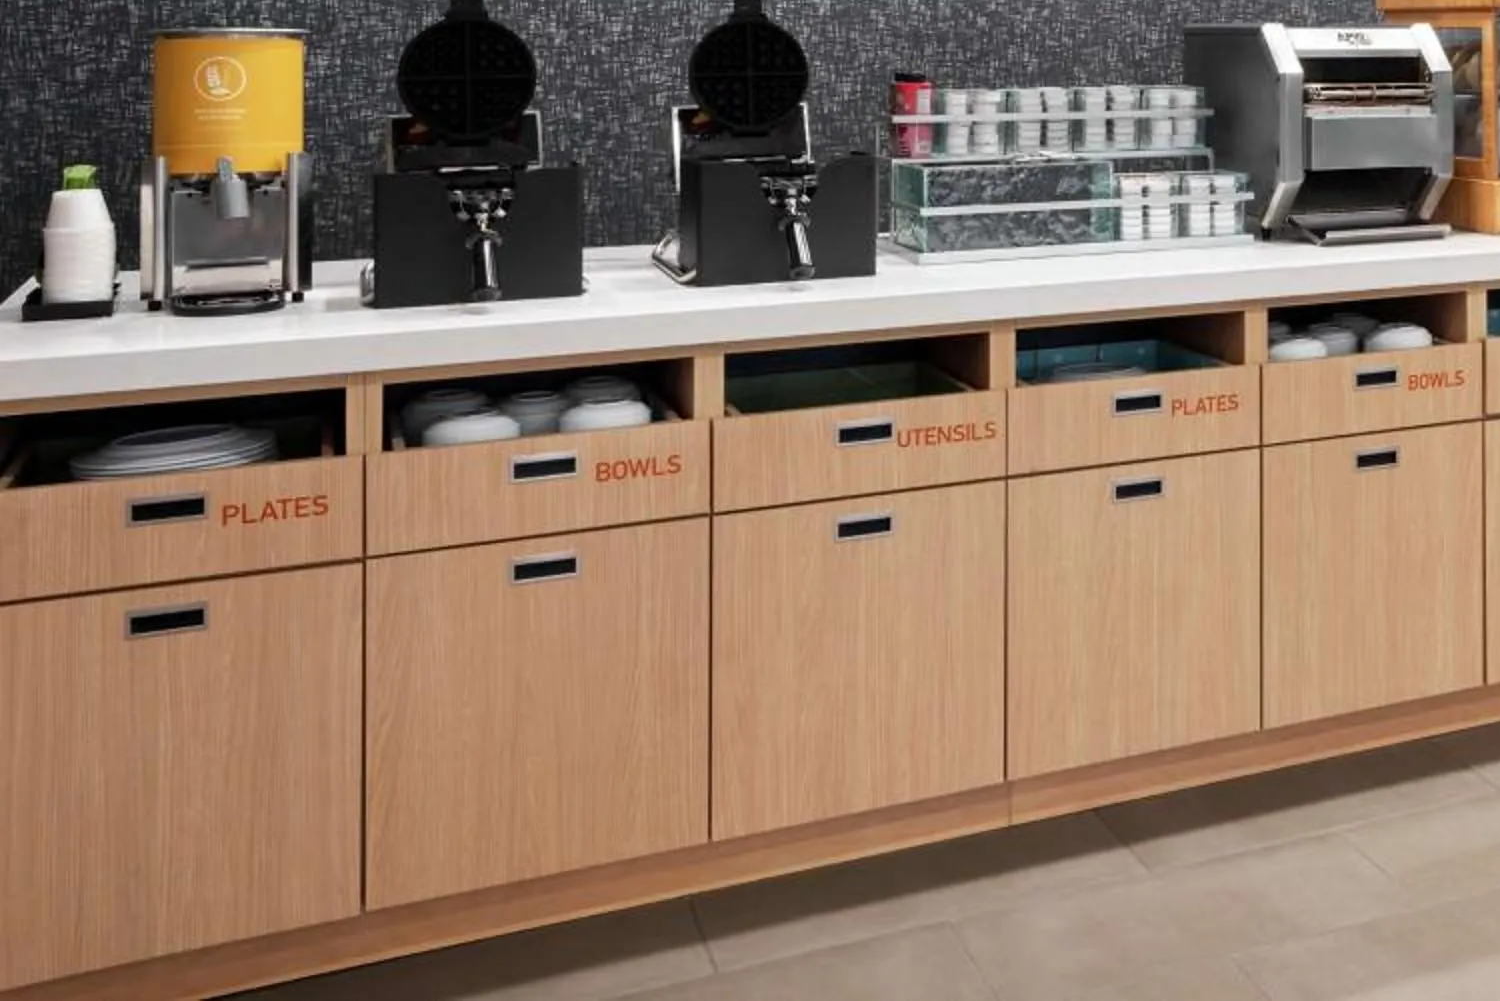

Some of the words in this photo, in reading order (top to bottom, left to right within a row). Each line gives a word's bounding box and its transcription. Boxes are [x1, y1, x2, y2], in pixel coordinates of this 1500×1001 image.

[1407, 370, 1465, 391] BOWLS
[1171, 394, 1239, 416] PLATES
[896, 422, 997, 448] UTENSILS
[595, 454, 683, 482] BOWLS
[221, 495, 329, 527] PLATES
